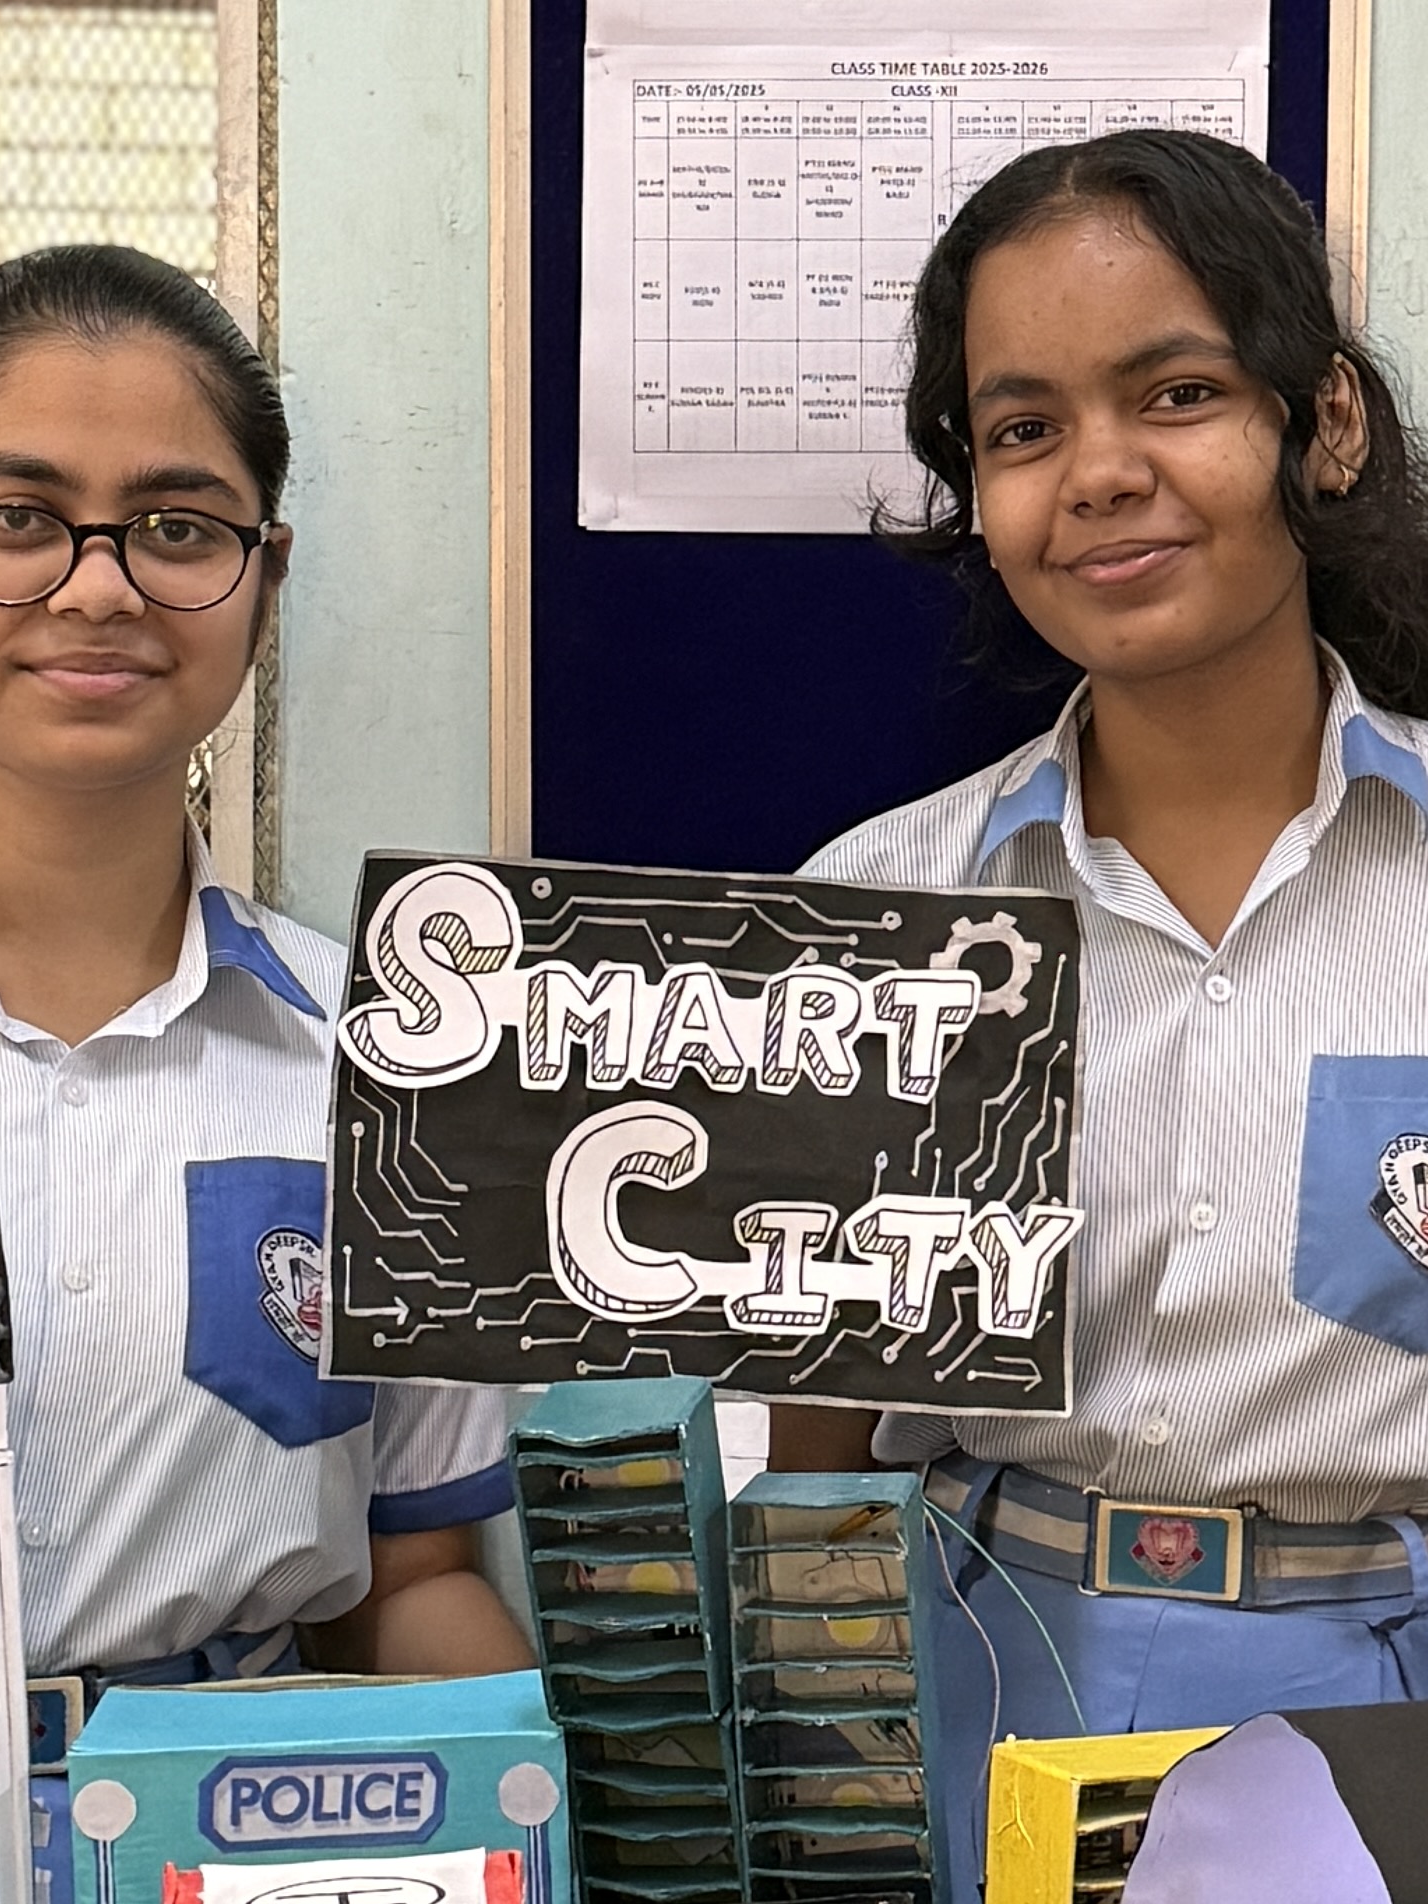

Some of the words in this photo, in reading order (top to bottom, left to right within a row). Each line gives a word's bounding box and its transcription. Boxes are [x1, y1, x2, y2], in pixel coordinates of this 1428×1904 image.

[830, 62, 876, 75] CLASS
[879, 62, 918, 75] TIME
[922, 62, 966, 75] TABLE
[970, 62, 1049, 75] 2025-2026
[890, 84, 932, 97] CLASS
[229, 1770, 425, 1828] POLICE
